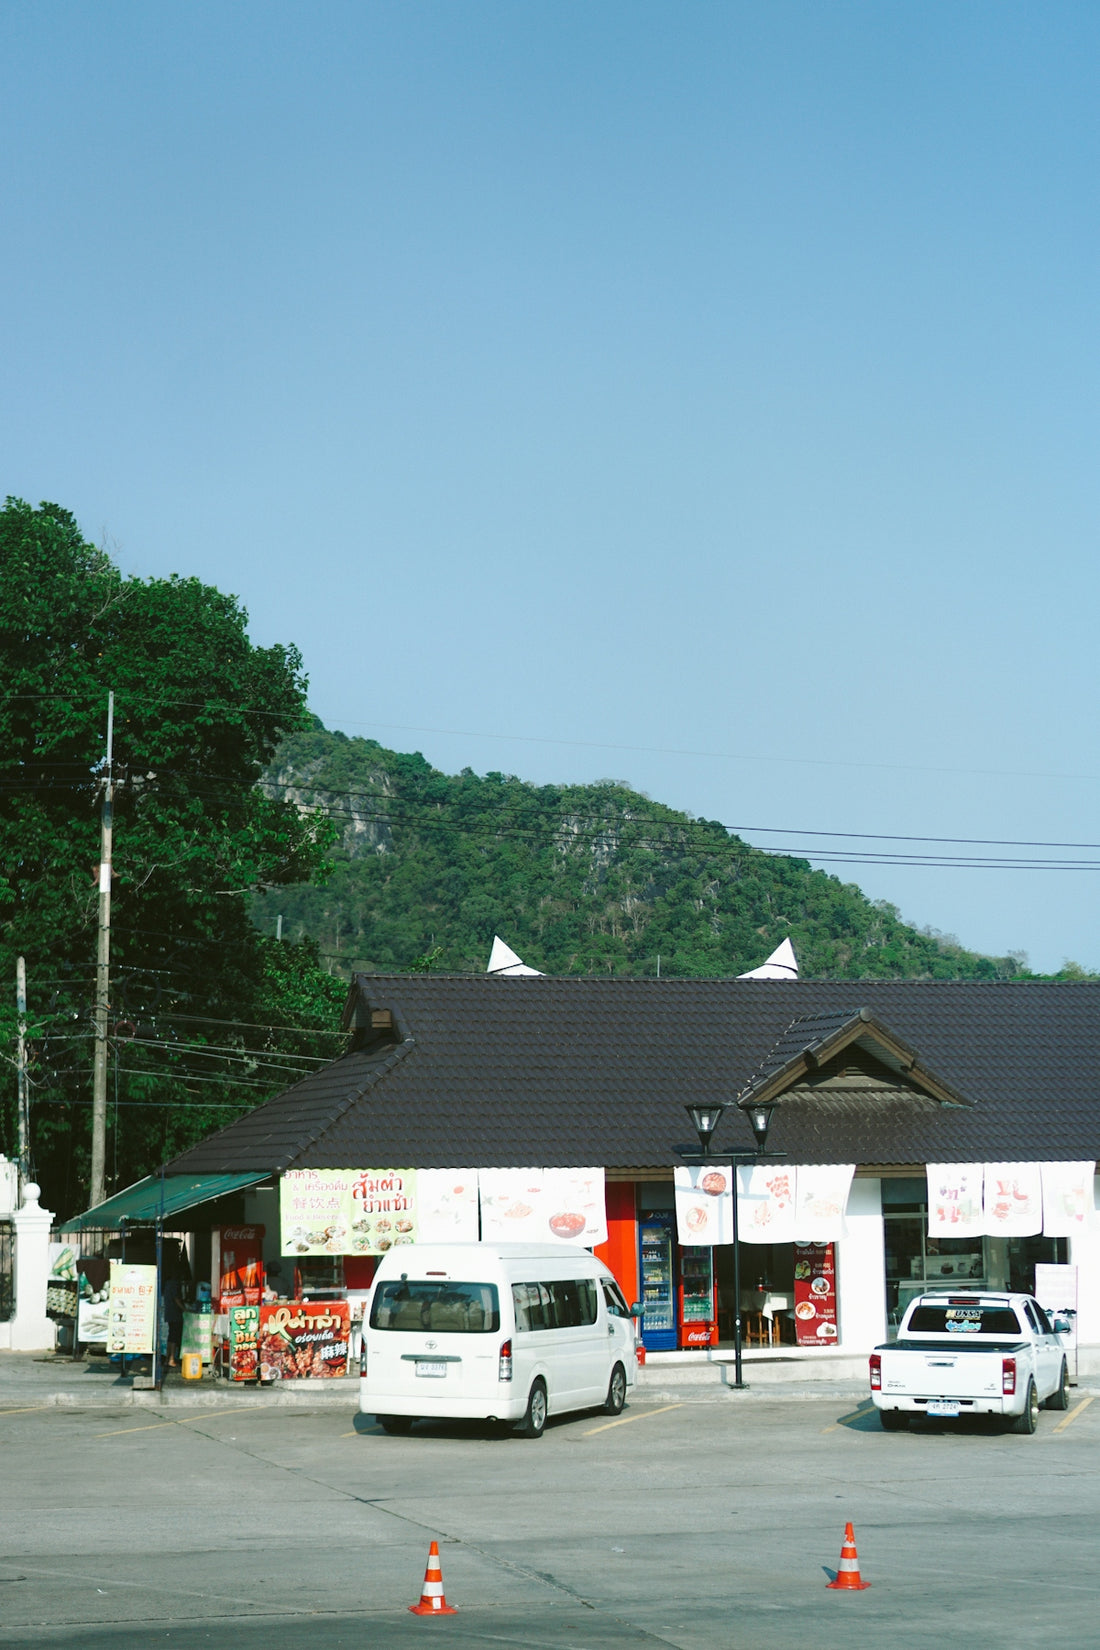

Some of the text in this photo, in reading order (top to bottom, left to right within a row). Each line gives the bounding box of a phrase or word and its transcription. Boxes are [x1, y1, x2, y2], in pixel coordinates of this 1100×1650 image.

[284, 1170, 318, 1180] อาหาร
[304, 1178, 348, 1191] เครื่องดื่ม
[352, 1172, 403, 1199] ส้มตำ
[224, 1228, 256, 1240] Coca-Cola
[234, 1308, 257, 1325] ลูก
[688, 1331, 711, 1342] Coca-Cola
[234, 1343, 257, 1351] ทอด
